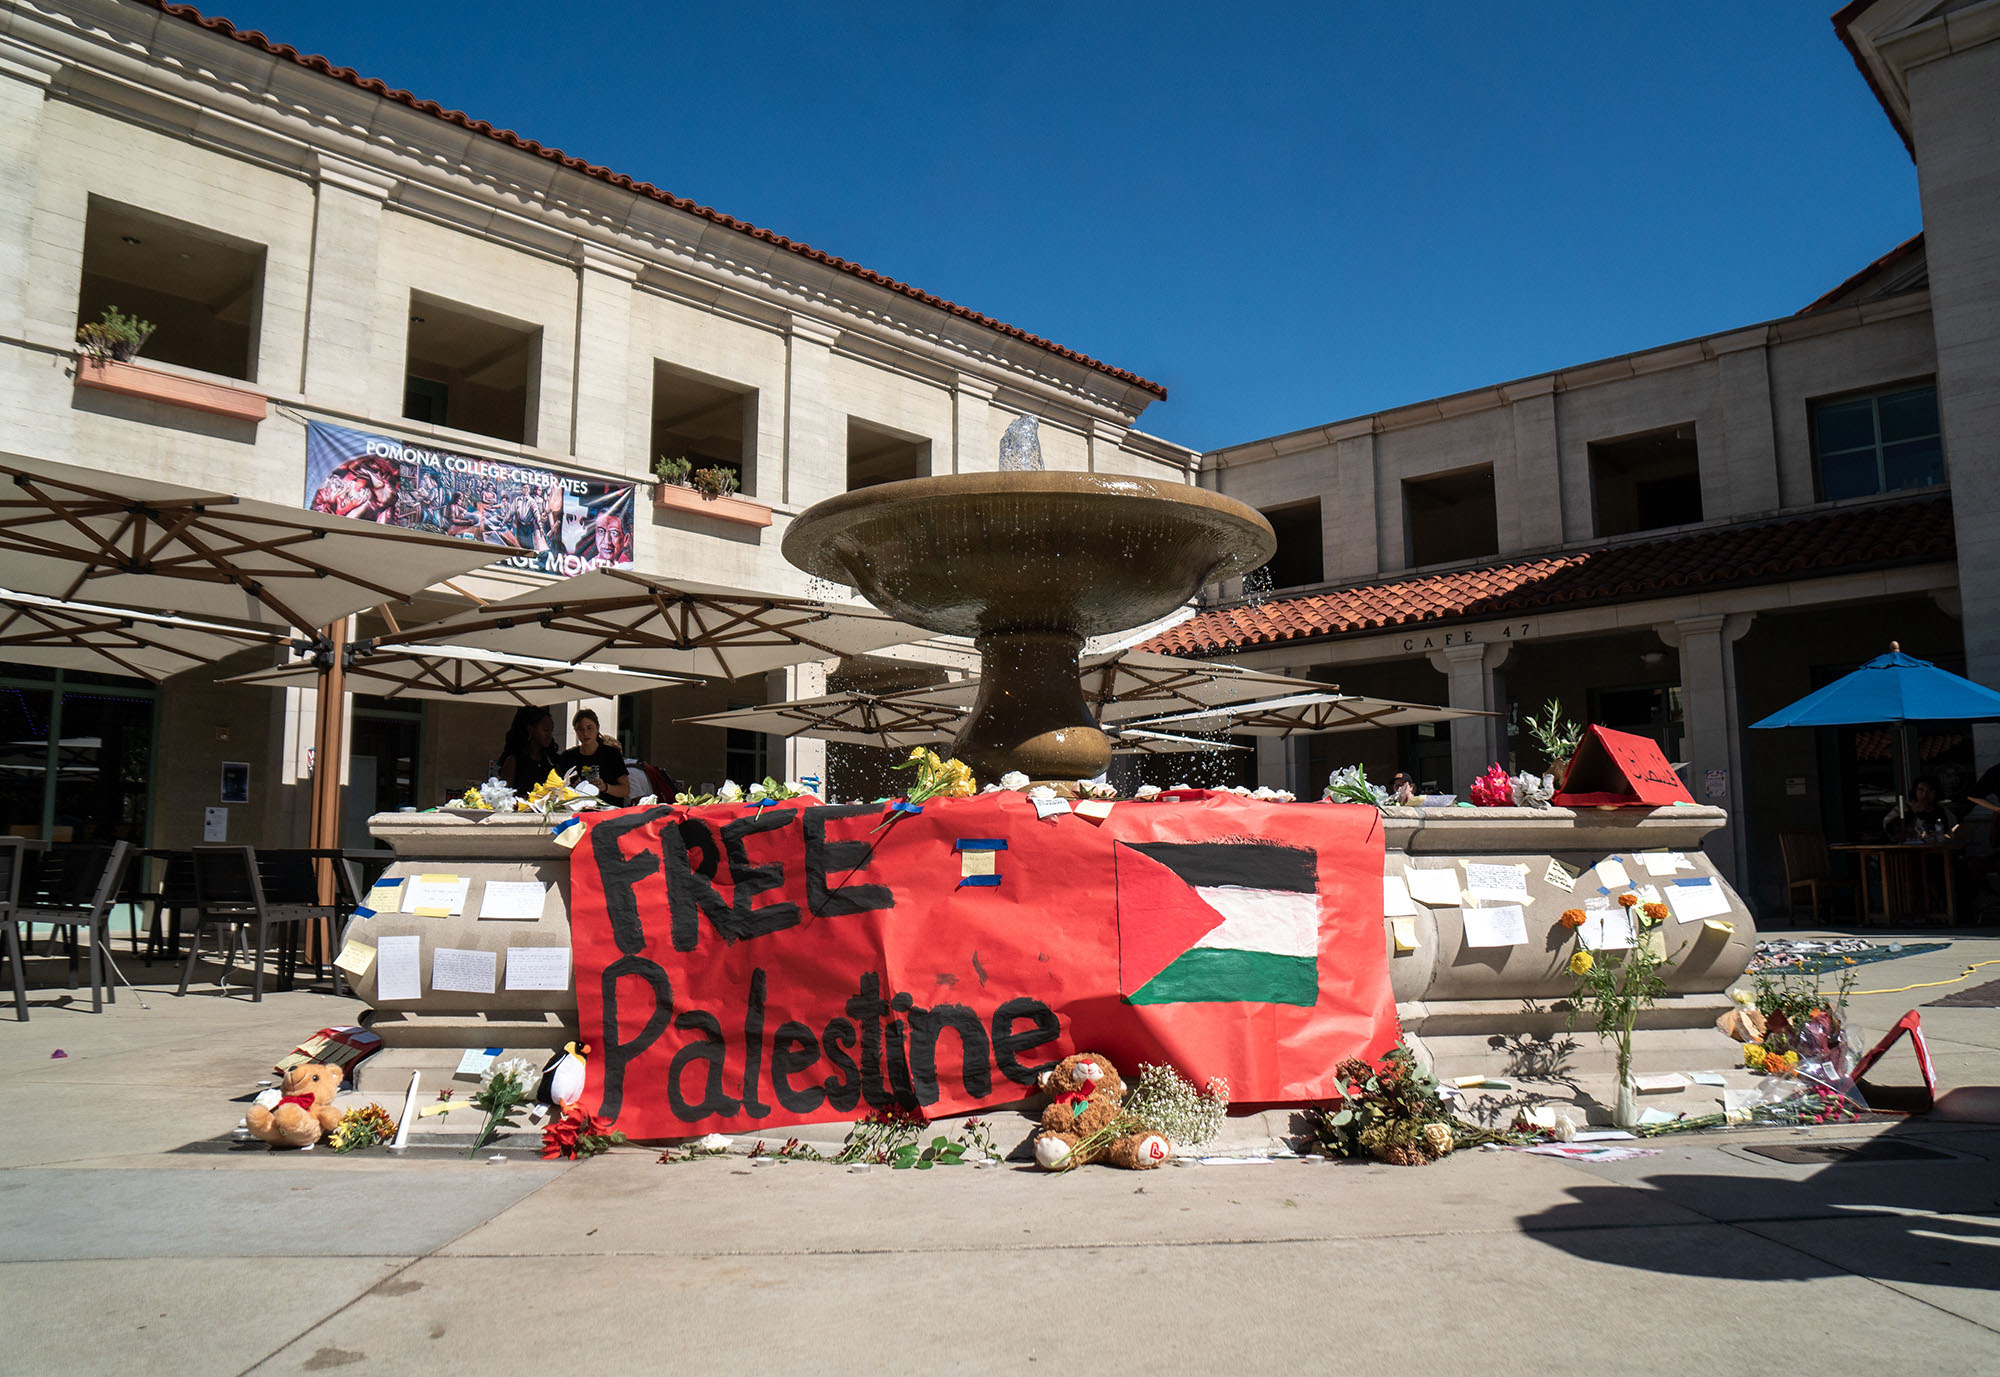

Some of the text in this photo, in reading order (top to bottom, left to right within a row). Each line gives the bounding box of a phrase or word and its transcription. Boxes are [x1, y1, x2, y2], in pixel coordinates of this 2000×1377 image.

[366, 441, 588, 495] POMONA COLLEGE CELEBRATES
[1403, 624, 1530, 651] CAFE 47
[591, 803, 895, 955] FREE
[598, 955, 1066, 1127] Palestine
